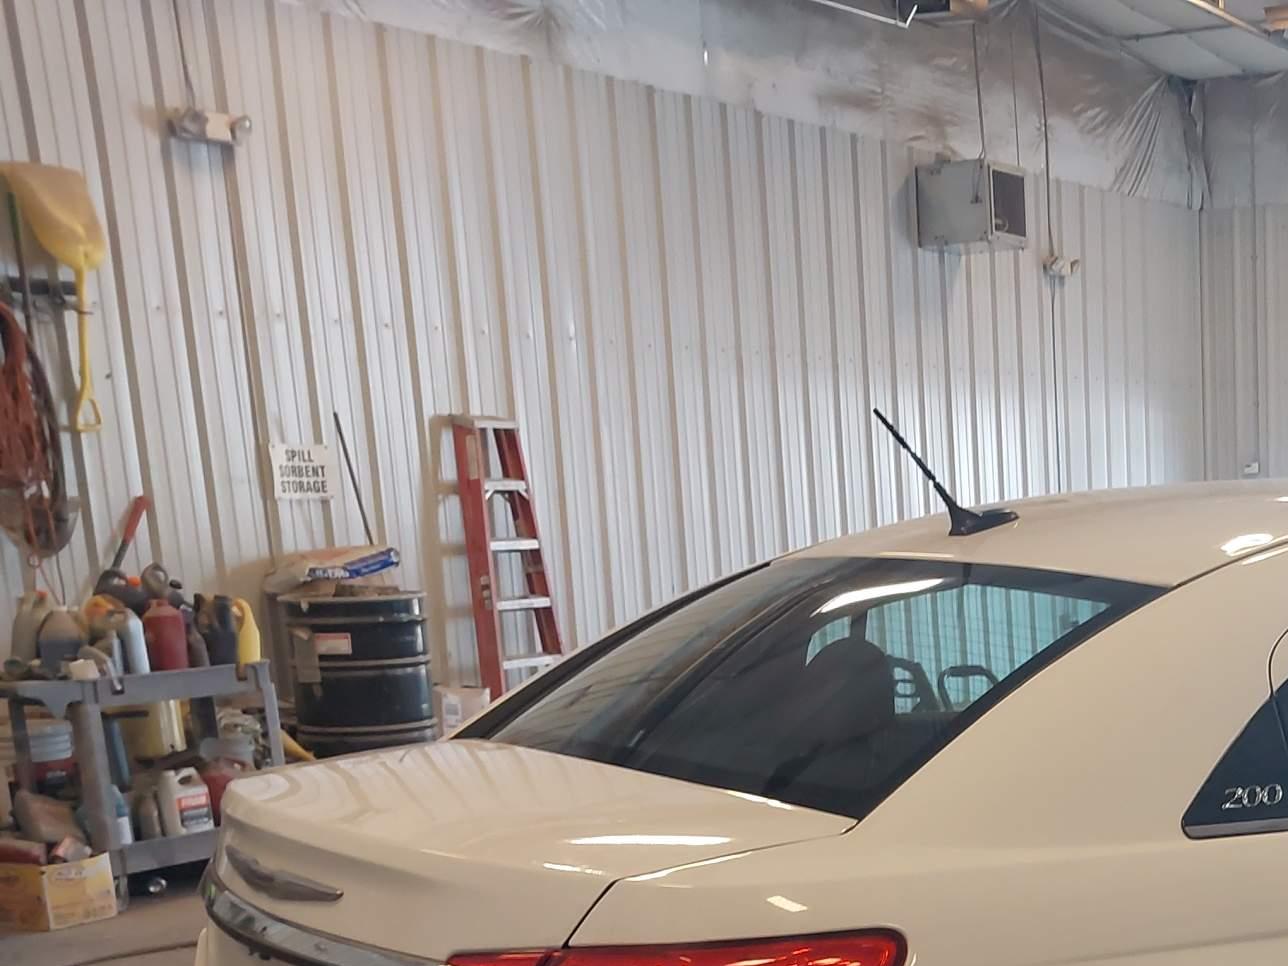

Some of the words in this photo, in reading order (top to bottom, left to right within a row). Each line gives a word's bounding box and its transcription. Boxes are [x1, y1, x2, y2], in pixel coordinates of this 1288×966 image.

[285, 449, 314, 462] SPILL
[279, 464, 326, 478] SORBENT
[280, 480, 328, 494] STORAGE
[1222, 783, 1283, 810] 200
